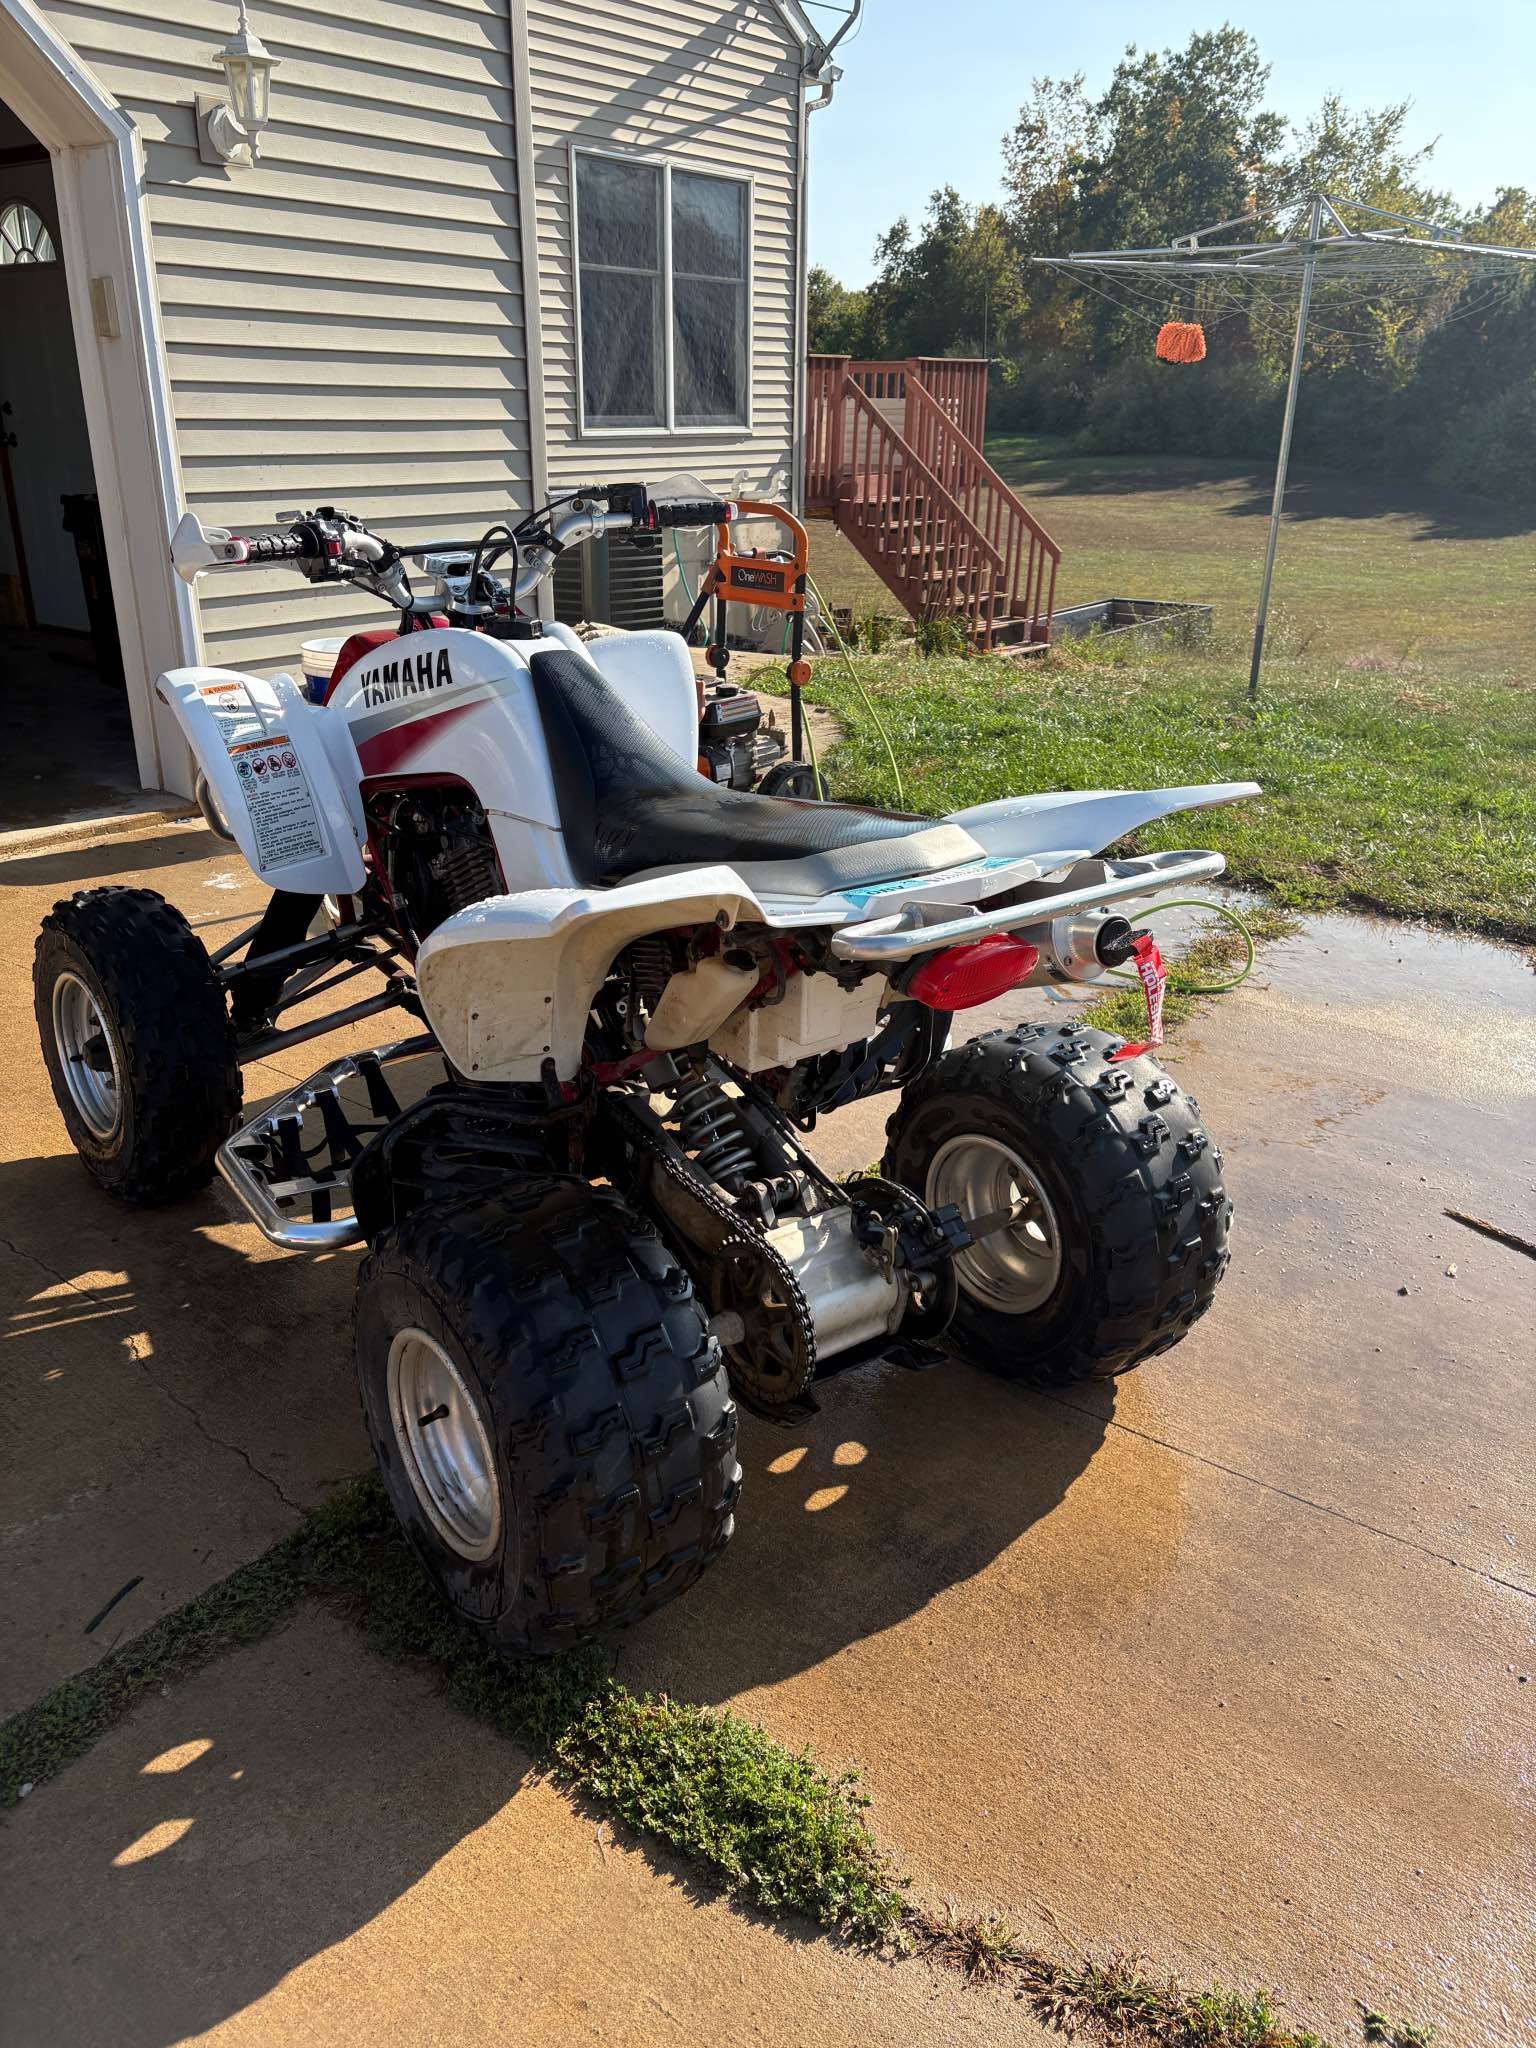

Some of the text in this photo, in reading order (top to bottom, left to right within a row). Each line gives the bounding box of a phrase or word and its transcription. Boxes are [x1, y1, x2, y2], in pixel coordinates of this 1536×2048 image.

[737, 568, 777, 585] OneWASH
[360, 648, 453, 709] YAMAHA
[226, 703, 236, 711] 16
